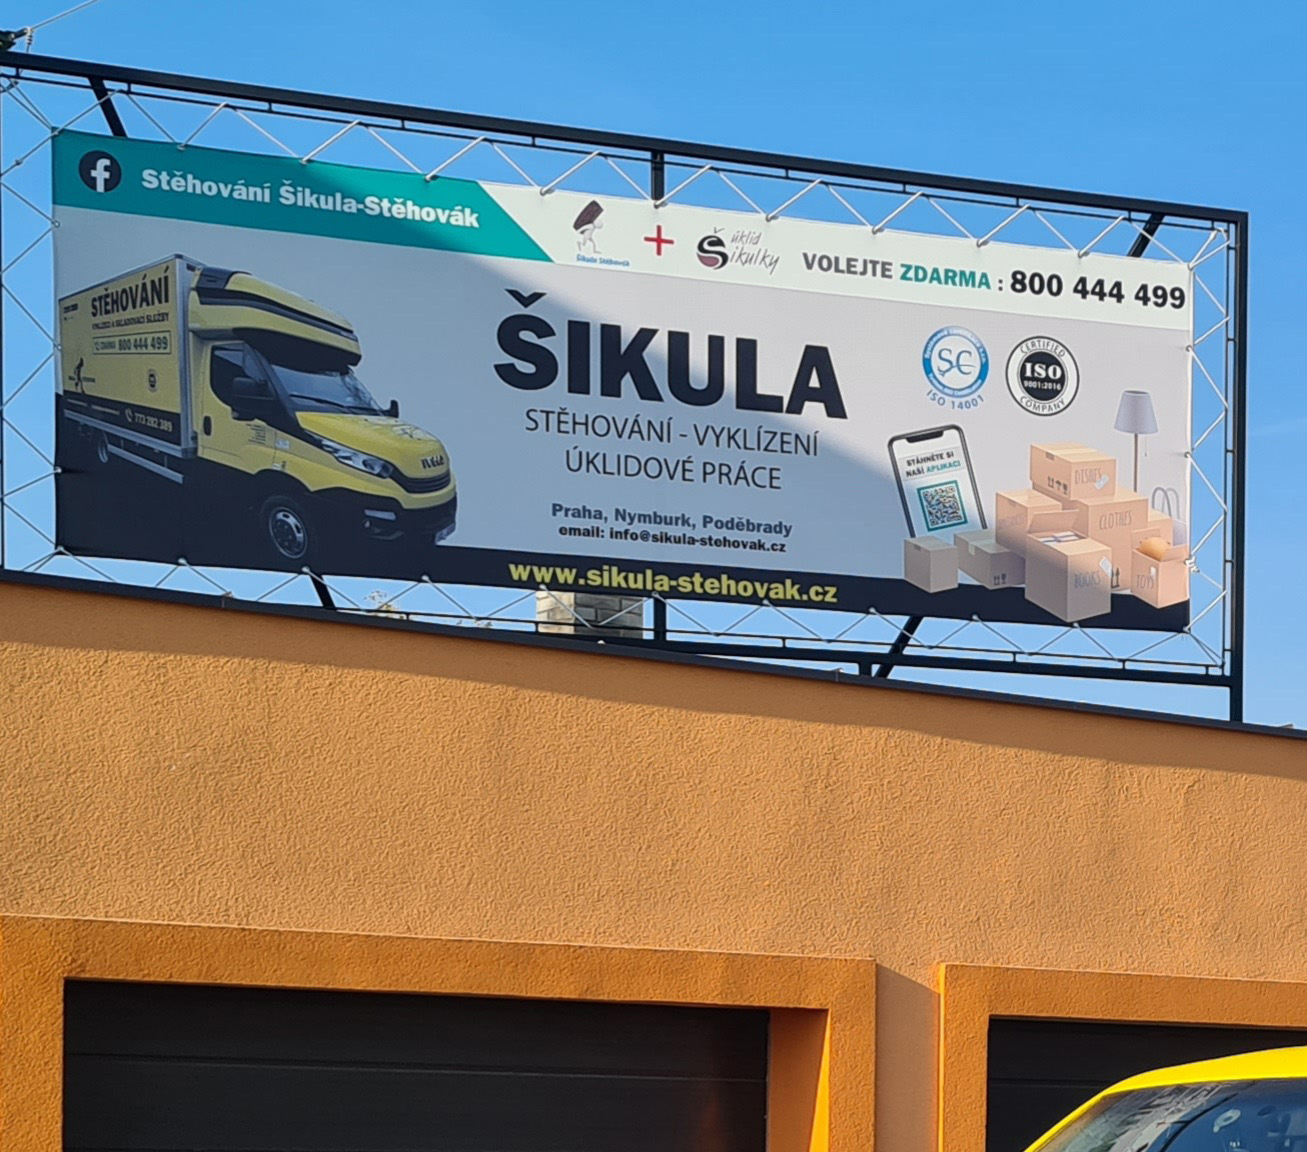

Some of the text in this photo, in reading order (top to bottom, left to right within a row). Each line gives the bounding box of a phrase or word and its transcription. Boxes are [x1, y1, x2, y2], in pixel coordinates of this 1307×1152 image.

[141, 168, 480, 228] Stěhování Šikula-Stěhovák
[91, 265, 170, 317] STĚHOVÁNÍ
[801, 251, 894, 280] VOLEJTE
[899, 263, 992, 290] ZDARMA
[1010, 270, 1064, 298] 800
[1072, 276, 1126, 304] 444
[1134, 283, 1187, 309] 499
[150, 336, 168, 350] 499
[493, 288, 849, 420] ŠIKULA
[1019, 340, 1066, 358] CERTIFIED
[1024, 362, 1063, 380] ISO
[926, 389, 985, 410] ISO 14001
[1019, 395, 1066, 413] COMPANY
[525, 406, 674, 444] STĚHOVÁNÍ
[693, 423, 820, 457] VYKLÍZENÍ
[565, 446, 783, 490] ÚKLIDOVÉ PRÁCE
[1074, 467, 1102, 486] DISHES
[551, 502, 794, 538] Praha, Nymburk, Poděbrady
[1099, 510, 1133, 531] CLOTHES
[558, 523, 788, 554] email: info@sikula-stehovak.cz
[508, 561, 839, 604] www.sikula-stehovak.cz
[1136, 573, 1155, 590] TOYS
